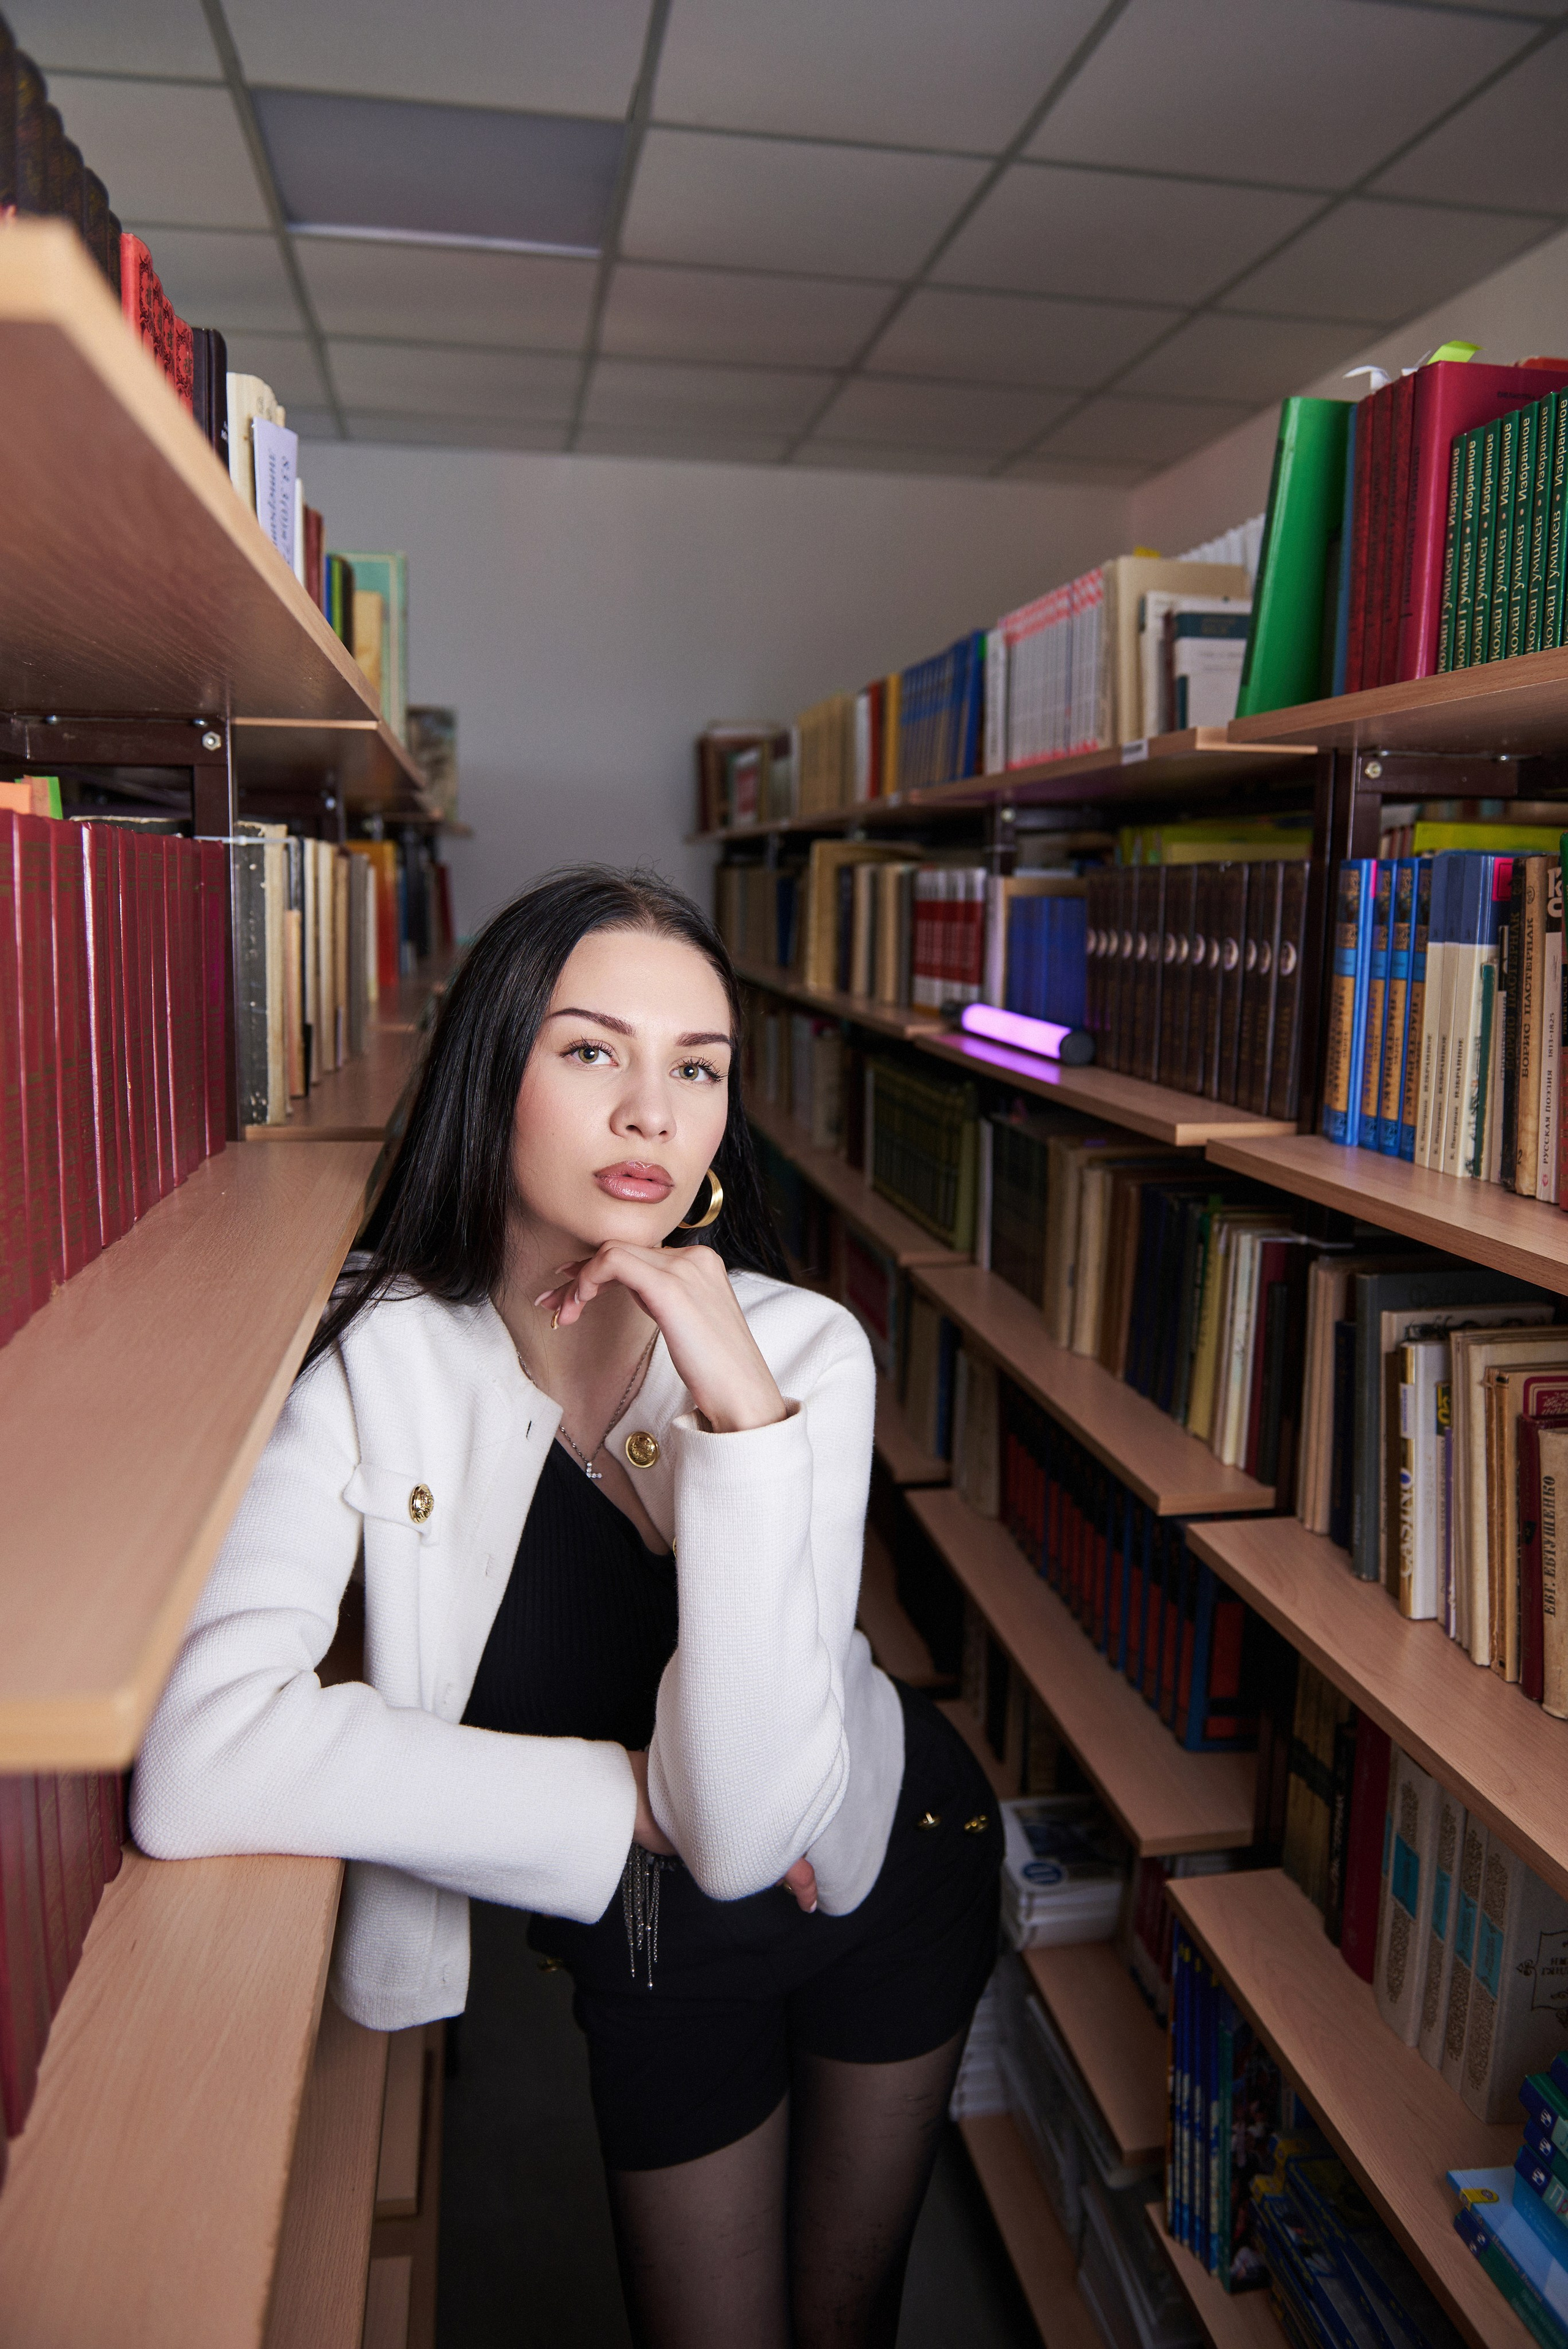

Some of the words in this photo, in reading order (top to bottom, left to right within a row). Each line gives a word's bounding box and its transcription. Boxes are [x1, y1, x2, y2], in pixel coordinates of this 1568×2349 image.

[1438, 625, 1449, 672] колай
[1448, 447, 1460, 526] Избранное
[1457, 619, 1466, 668] колай
[1464, 440, 1477, 521] Избранное
[1473, 616, 1484, 664] колай
[1482, 434, 1494, 515] Избранное
[1491, 609, 1502, 660] колай
[1500, 423, 1512, 506] Избранное
[1509, 607, 1520, 657] колай
[1518, 417, 1531, 502] Избранное
[1526, 599, 1538, 652] колай
[1536, 406, 1549, 492] Избранное
[1544, 596, 1556, 649] колай
[1554, 399, 1568, 486] Избранное
[1521, 1023, 1531, 1079] БОРИС
[1523, 916, 1534, 1015] ПАСТЕРНАК
[1542, 1116, 1551, 1165] РУССКАЯ
[1542, 1476, 1556, 1579] ЕВТУШЕНКО
[1543, 1583, 1556, 1618] ЕВГ.
